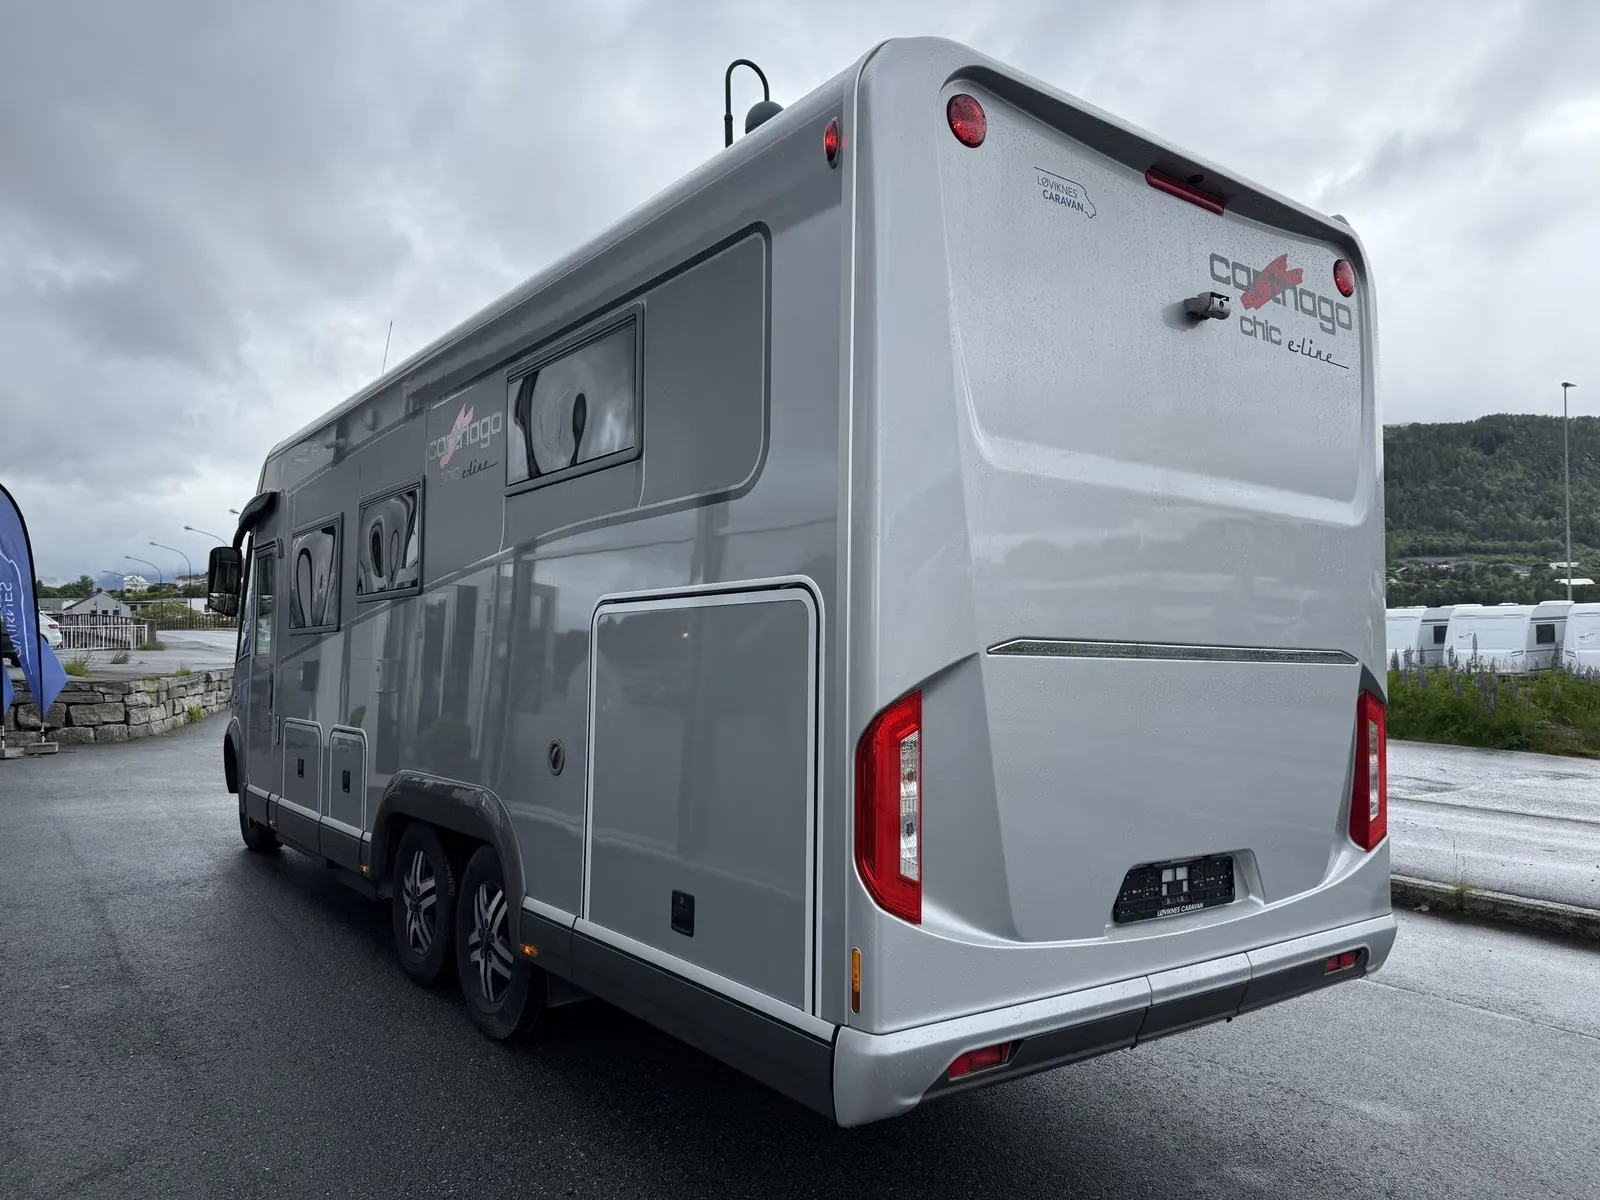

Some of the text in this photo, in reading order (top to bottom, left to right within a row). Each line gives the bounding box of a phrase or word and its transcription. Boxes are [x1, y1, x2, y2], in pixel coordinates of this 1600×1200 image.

[1037, 175, 1078, 199] LØVIKNES
[1042, 189, 1084, 213] CARAVAN
[1209, 252, 1353, 336] carthago
[1240, 315, 1349, 370] chic e-line
[1180, 902, 1204, 913] CARAVAN
